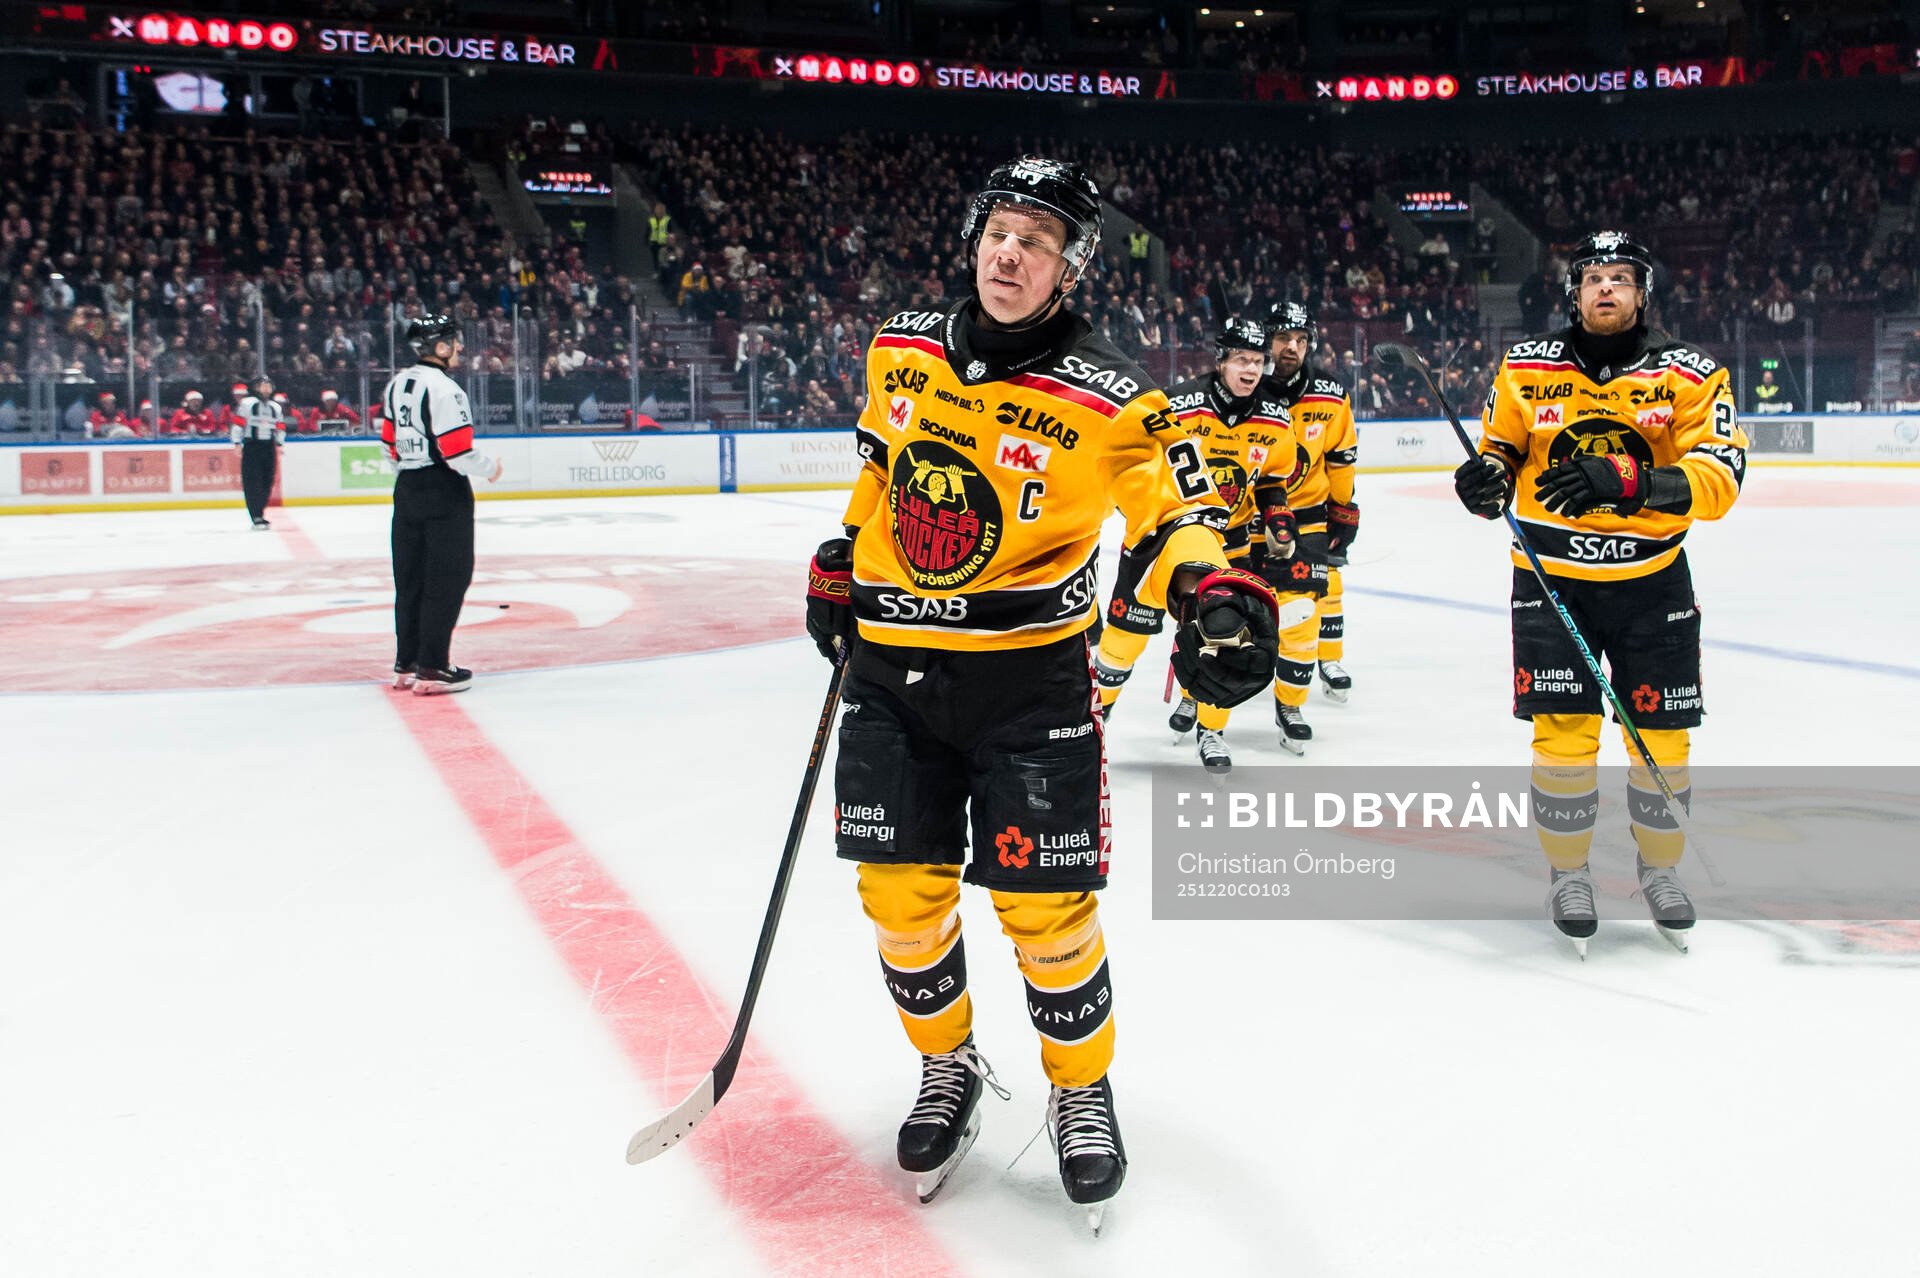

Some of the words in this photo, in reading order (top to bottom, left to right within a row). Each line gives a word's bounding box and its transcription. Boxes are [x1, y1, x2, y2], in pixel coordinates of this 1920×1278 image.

[142, 17, 296, 49] MANDO
[320, 28, 495, 59] STEAKHOUSE
[502, 42, 519, 62] &
[526, 43, 575, 64] BAR
[800, 56, 919, 84] MANDO
[937, 67, 1075, 94] STEAKHOUSE
[1080, 77, 1093, 94] &
[1099, 76, 1141, 95] BAR
[1338, 78, 1457, 99] MANDO
[1477, 70, 1627, 96] STEAKHOUSE
[1633, 70, 1648, 88] &
[1656, 65, 1703, 88] BAR
[884, 311, 945, 331] SSAB
[1509, 341, 1564, 358] SSAB
[1659, 349, 1715, 374] SSAB
[1053, 355, 1139, 399] SSAB
[934, 388, 960, 407] NIEMI
[1315, 379, 1343, 396] SSAB
[1535, 383, 1573, 400] LKAB
[1168, 392, 1204, 411] SSAB
[1261, 401, 1290, 420] SSAB
[1538, 408, 1560, 424] MAX
[919, 418, 977, 449] SCANIA
[1020, 406, 1079, 449] LKAB
[1001, 443, 1042, 469] MAX
[569, 464, 665, 482] TRELLEBORG
[900, 485, 979, 536] LULEÅ
[1020, 481, 1044, 520] C
[898, 507, 976, 570] HOCKEY
[980, 521, 997, 552] 1977
[1568, 535, 1637, 560] SSAB
[877, 594, 968, 621] SSAB
[1534, 667, 1574, 681] Luleå
[1534, 680, 1582, 694] Energi
[1664, 685, 1697, 699] Luleå
[1049, 722, 1094, 740] BAUER
[841, 802, 885, 821] Luleå
[841, 821, 895, 842] Energi
[1039, 828, 1090, 849] Luleå
[1039, 848, 1098, 867] Energi
[1038, 948, 1081, 965] BAUER
